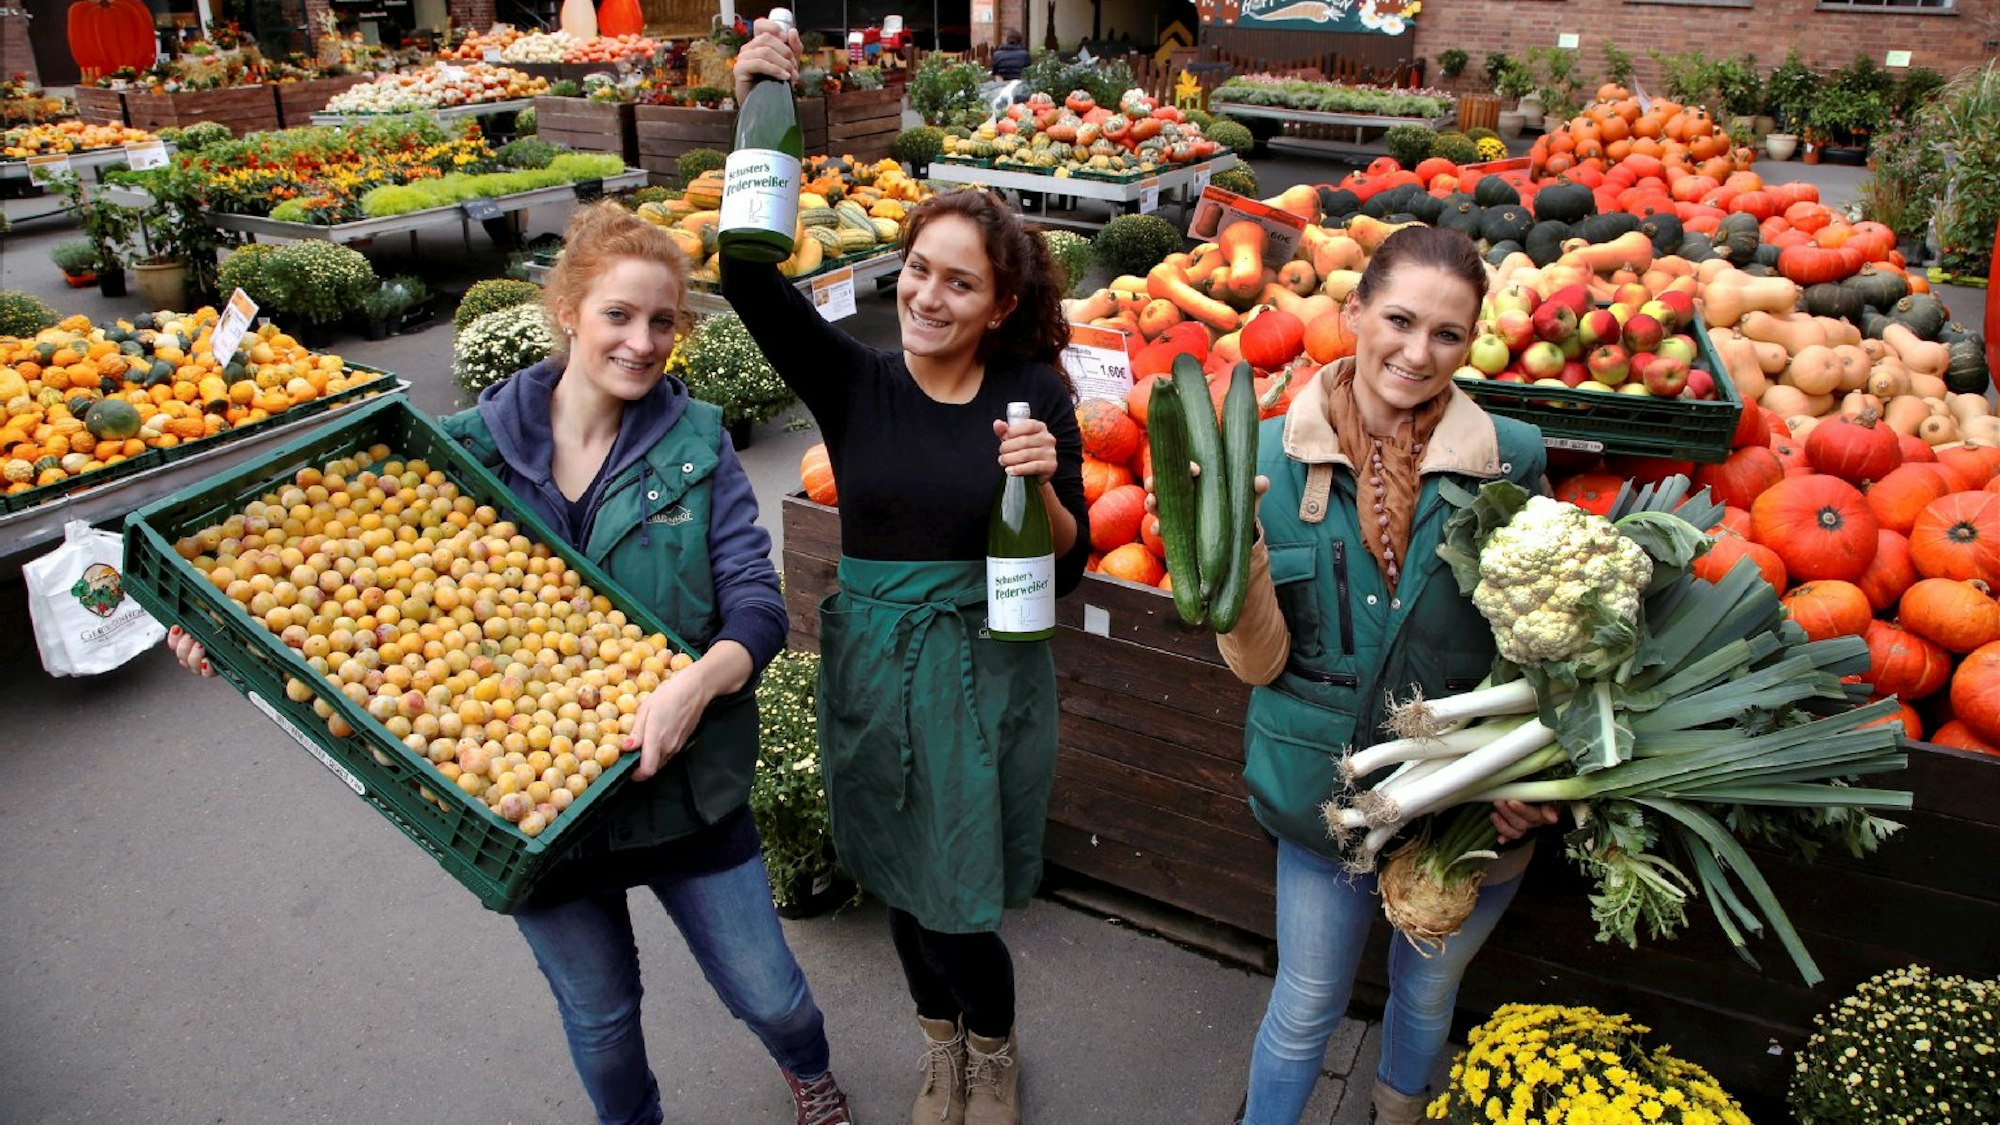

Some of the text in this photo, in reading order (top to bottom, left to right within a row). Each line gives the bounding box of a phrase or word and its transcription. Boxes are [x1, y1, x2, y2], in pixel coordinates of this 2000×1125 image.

[728, 162, 770, 181] Schuster's
[726, 175, 789, 197] Federweißer
[1100, 364, 1127, 380] 1,60€
[995, 572, 1033, 587] Schuster's
[995, 578, 1049, 601] Federweißer
